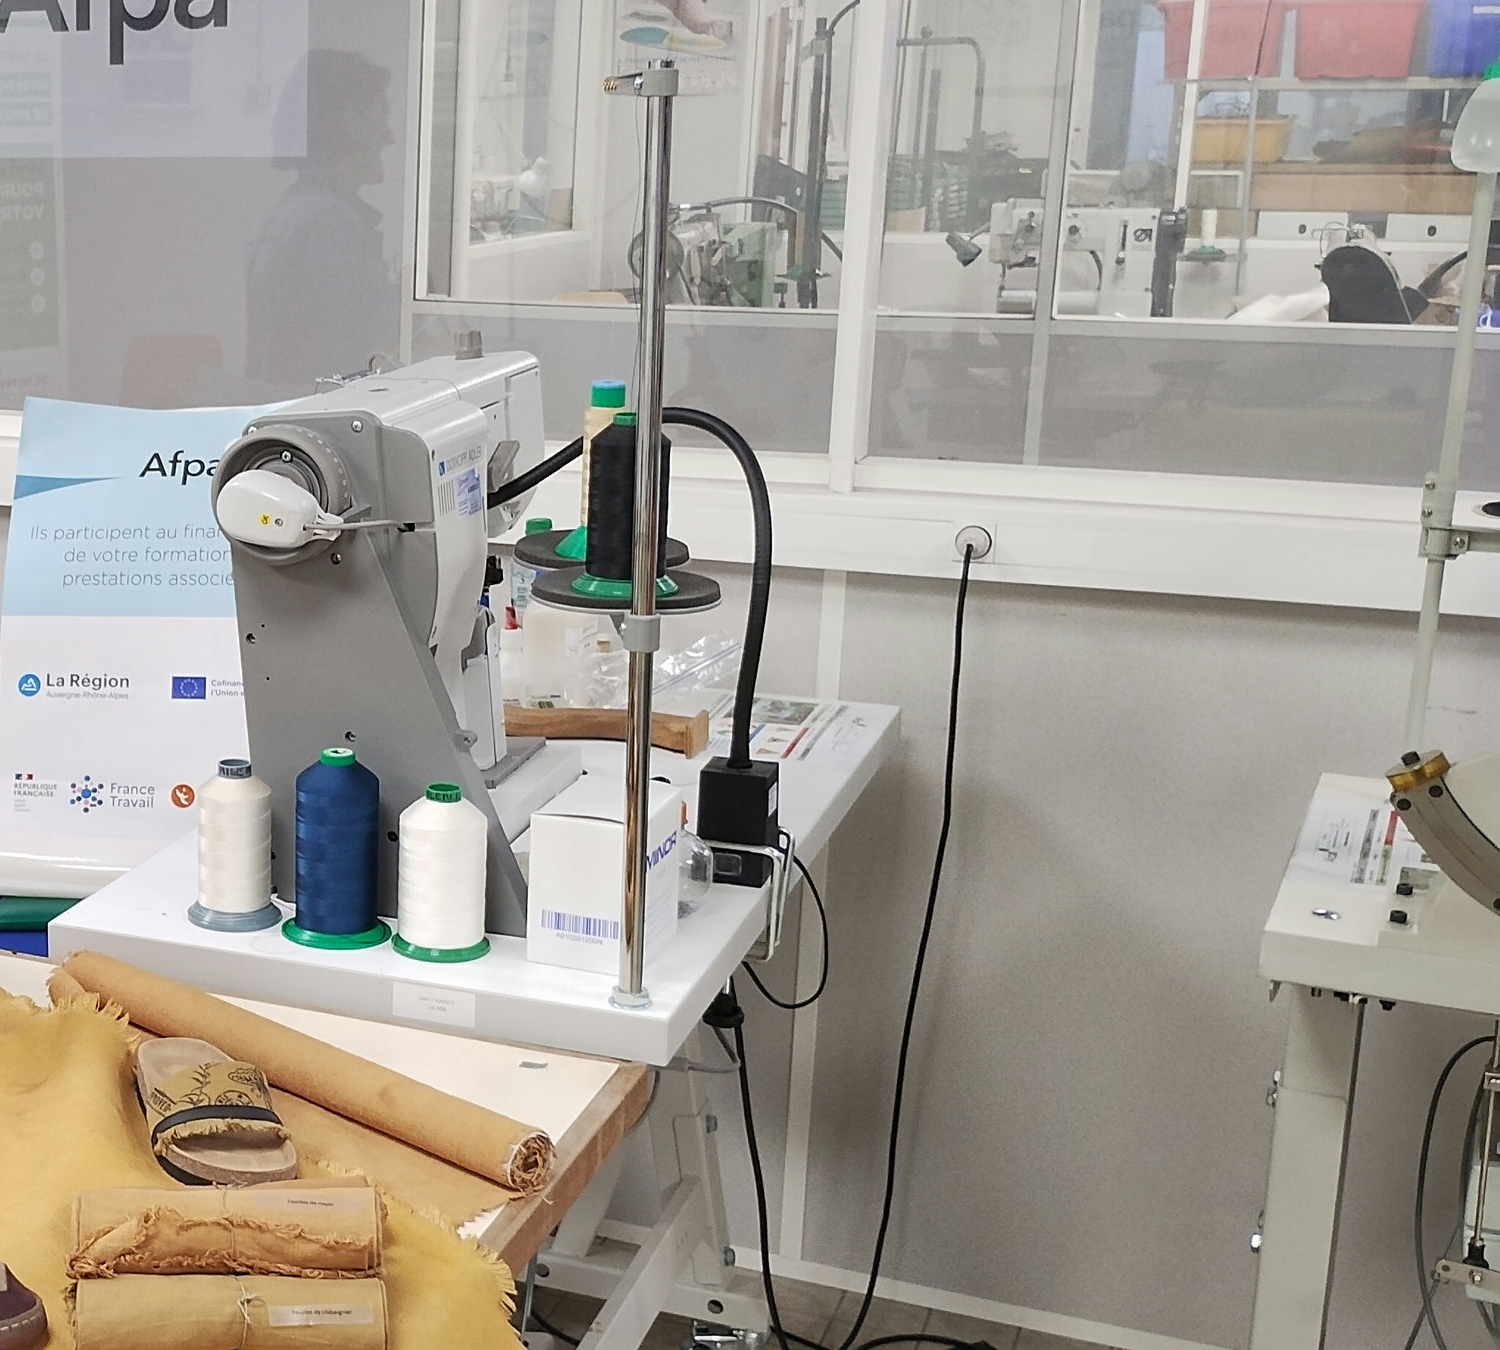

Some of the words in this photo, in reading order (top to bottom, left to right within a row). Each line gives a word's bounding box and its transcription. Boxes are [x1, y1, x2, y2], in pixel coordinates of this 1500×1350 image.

[30, 525, 48, 540] Ils
[54, 525, 150, 542] participent
[156, 527, 177, 539] au
[64, 547, 86, 562] de
[93, 549, 138, 562] votre
[63, 571, 162, 588] prestations
[46, 673, 65, 687] La
[70, 673, 130, 691] Région
[110, 783, 155, 795] France
[110, 796, 154, 808] Travail
